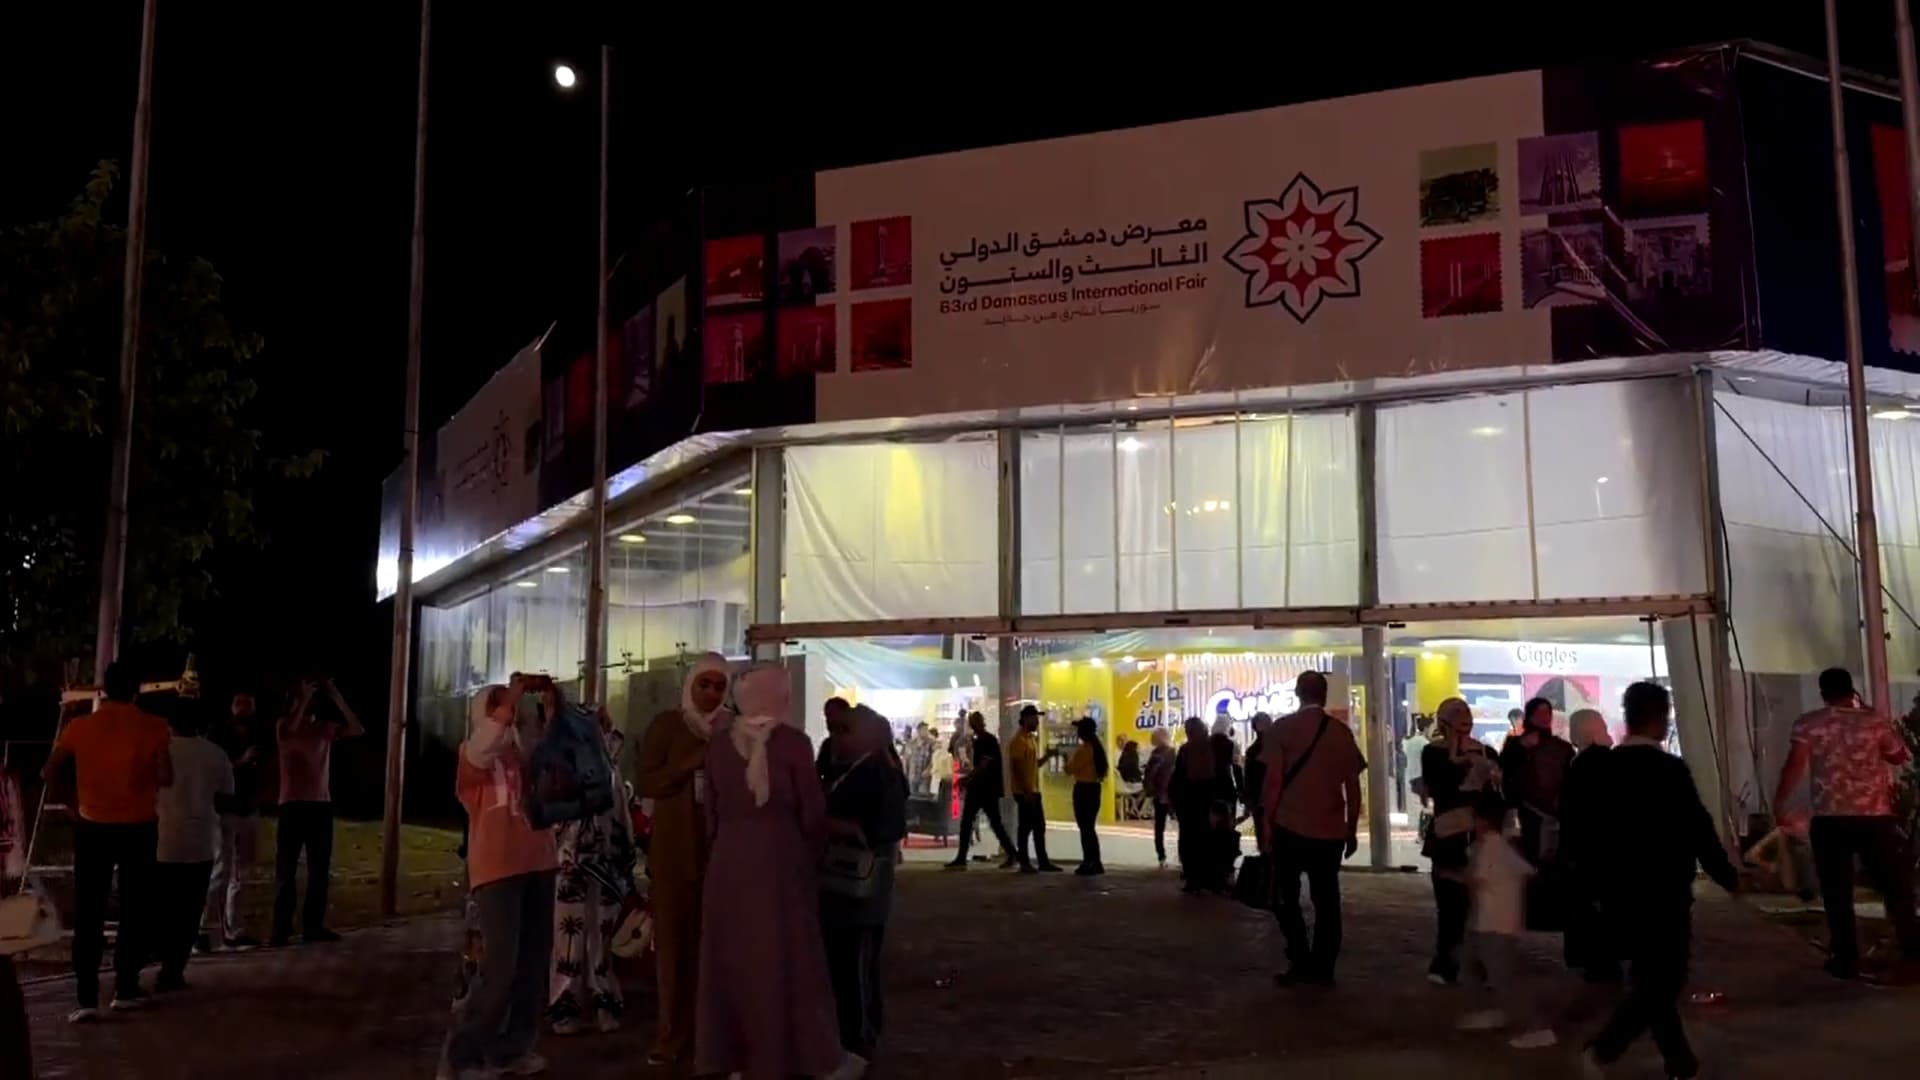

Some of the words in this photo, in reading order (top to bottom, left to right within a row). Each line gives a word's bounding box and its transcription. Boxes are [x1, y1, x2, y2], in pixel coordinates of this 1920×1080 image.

[1023, 228, 1106, 256] دمشق
[1112, 218, 1207, 246] معرض
[940, 231, 1018, 272] الدولي
[1078, 242, 1207, 275] الثالث
[940, 258, 1073, 294] والستون
[940, 297, 977, 314] 63rd
[981, 291, 1067, 309] Damascus
[1071, 277, 1173, 301] International
[1176, 273, 1207, 290] Fair
[1516, 644, 1578, 669] Giggles
